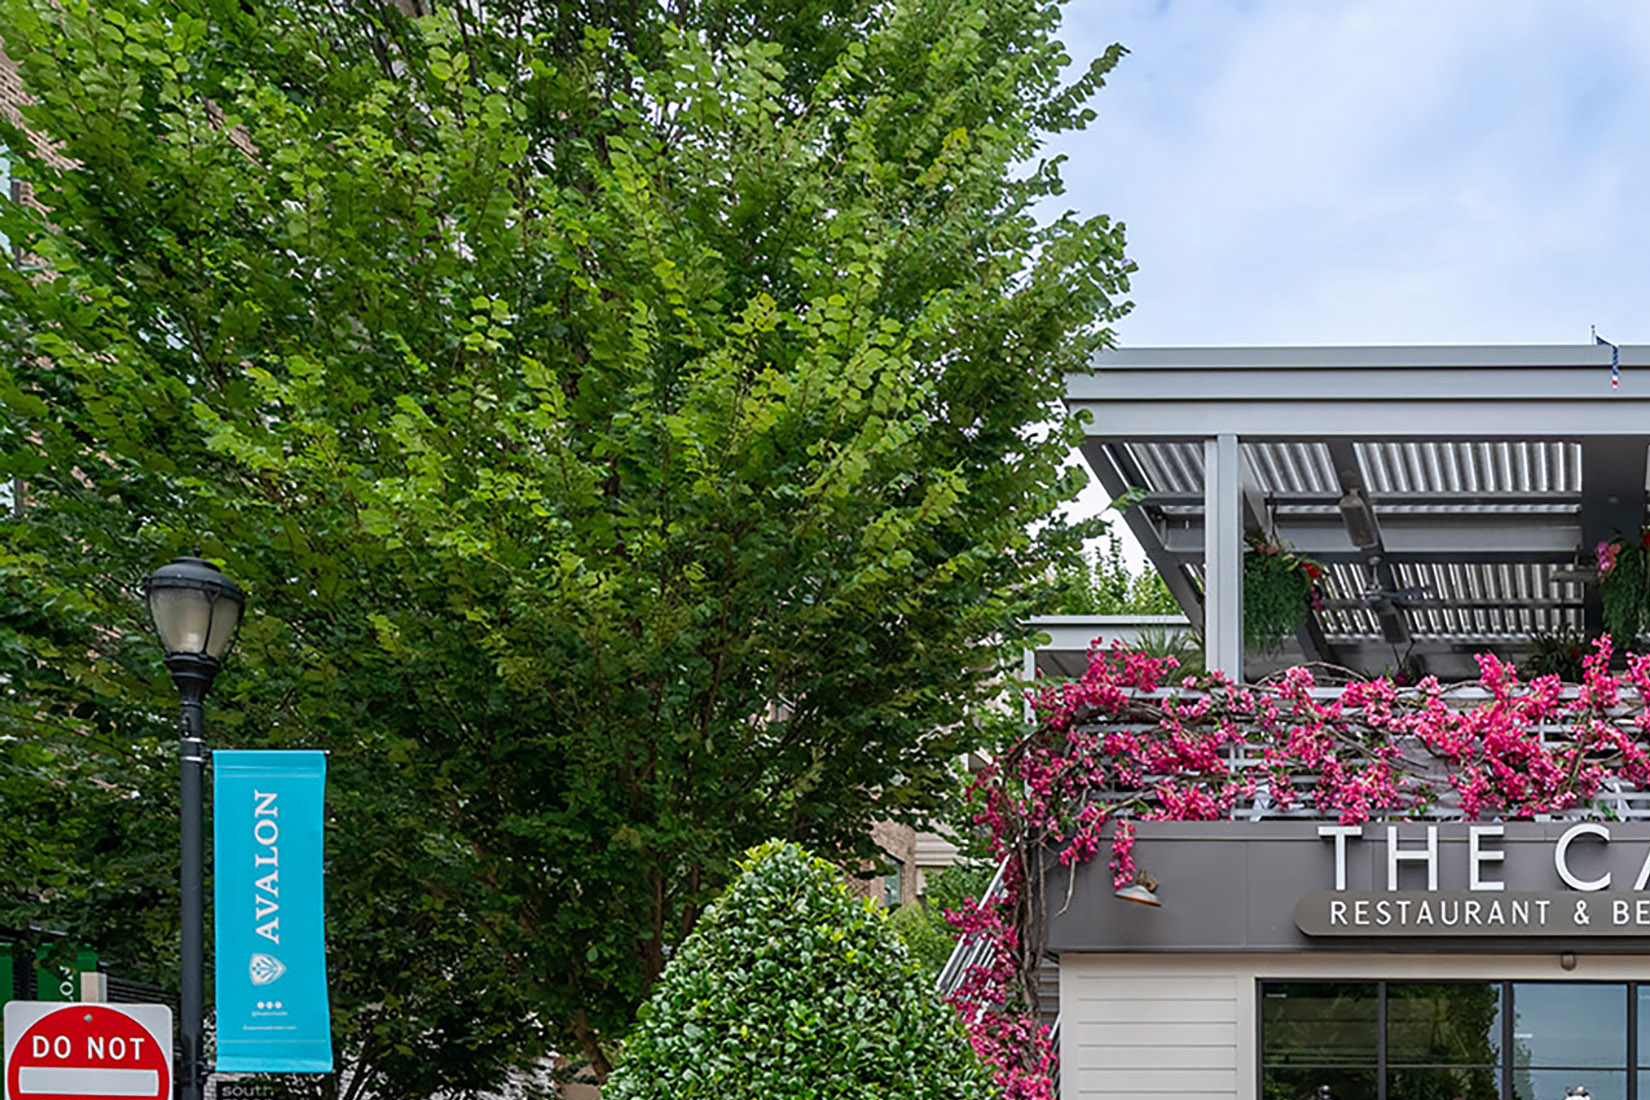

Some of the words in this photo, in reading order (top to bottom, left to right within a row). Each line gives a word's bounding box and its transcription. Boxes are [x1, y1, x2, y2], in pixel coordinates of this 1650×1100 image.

[253, 789, 280, 945] AVALON
[1317, 825, 1505, 892] THE
[1331, 900, 1549, 925] RESTAURANT
[1573, 900, 1591, 925] &
[32, 1035, 71, 1059] DO
[87, 1036, 145, 1060] NOT
[222, 1085, 274, 1097] south
